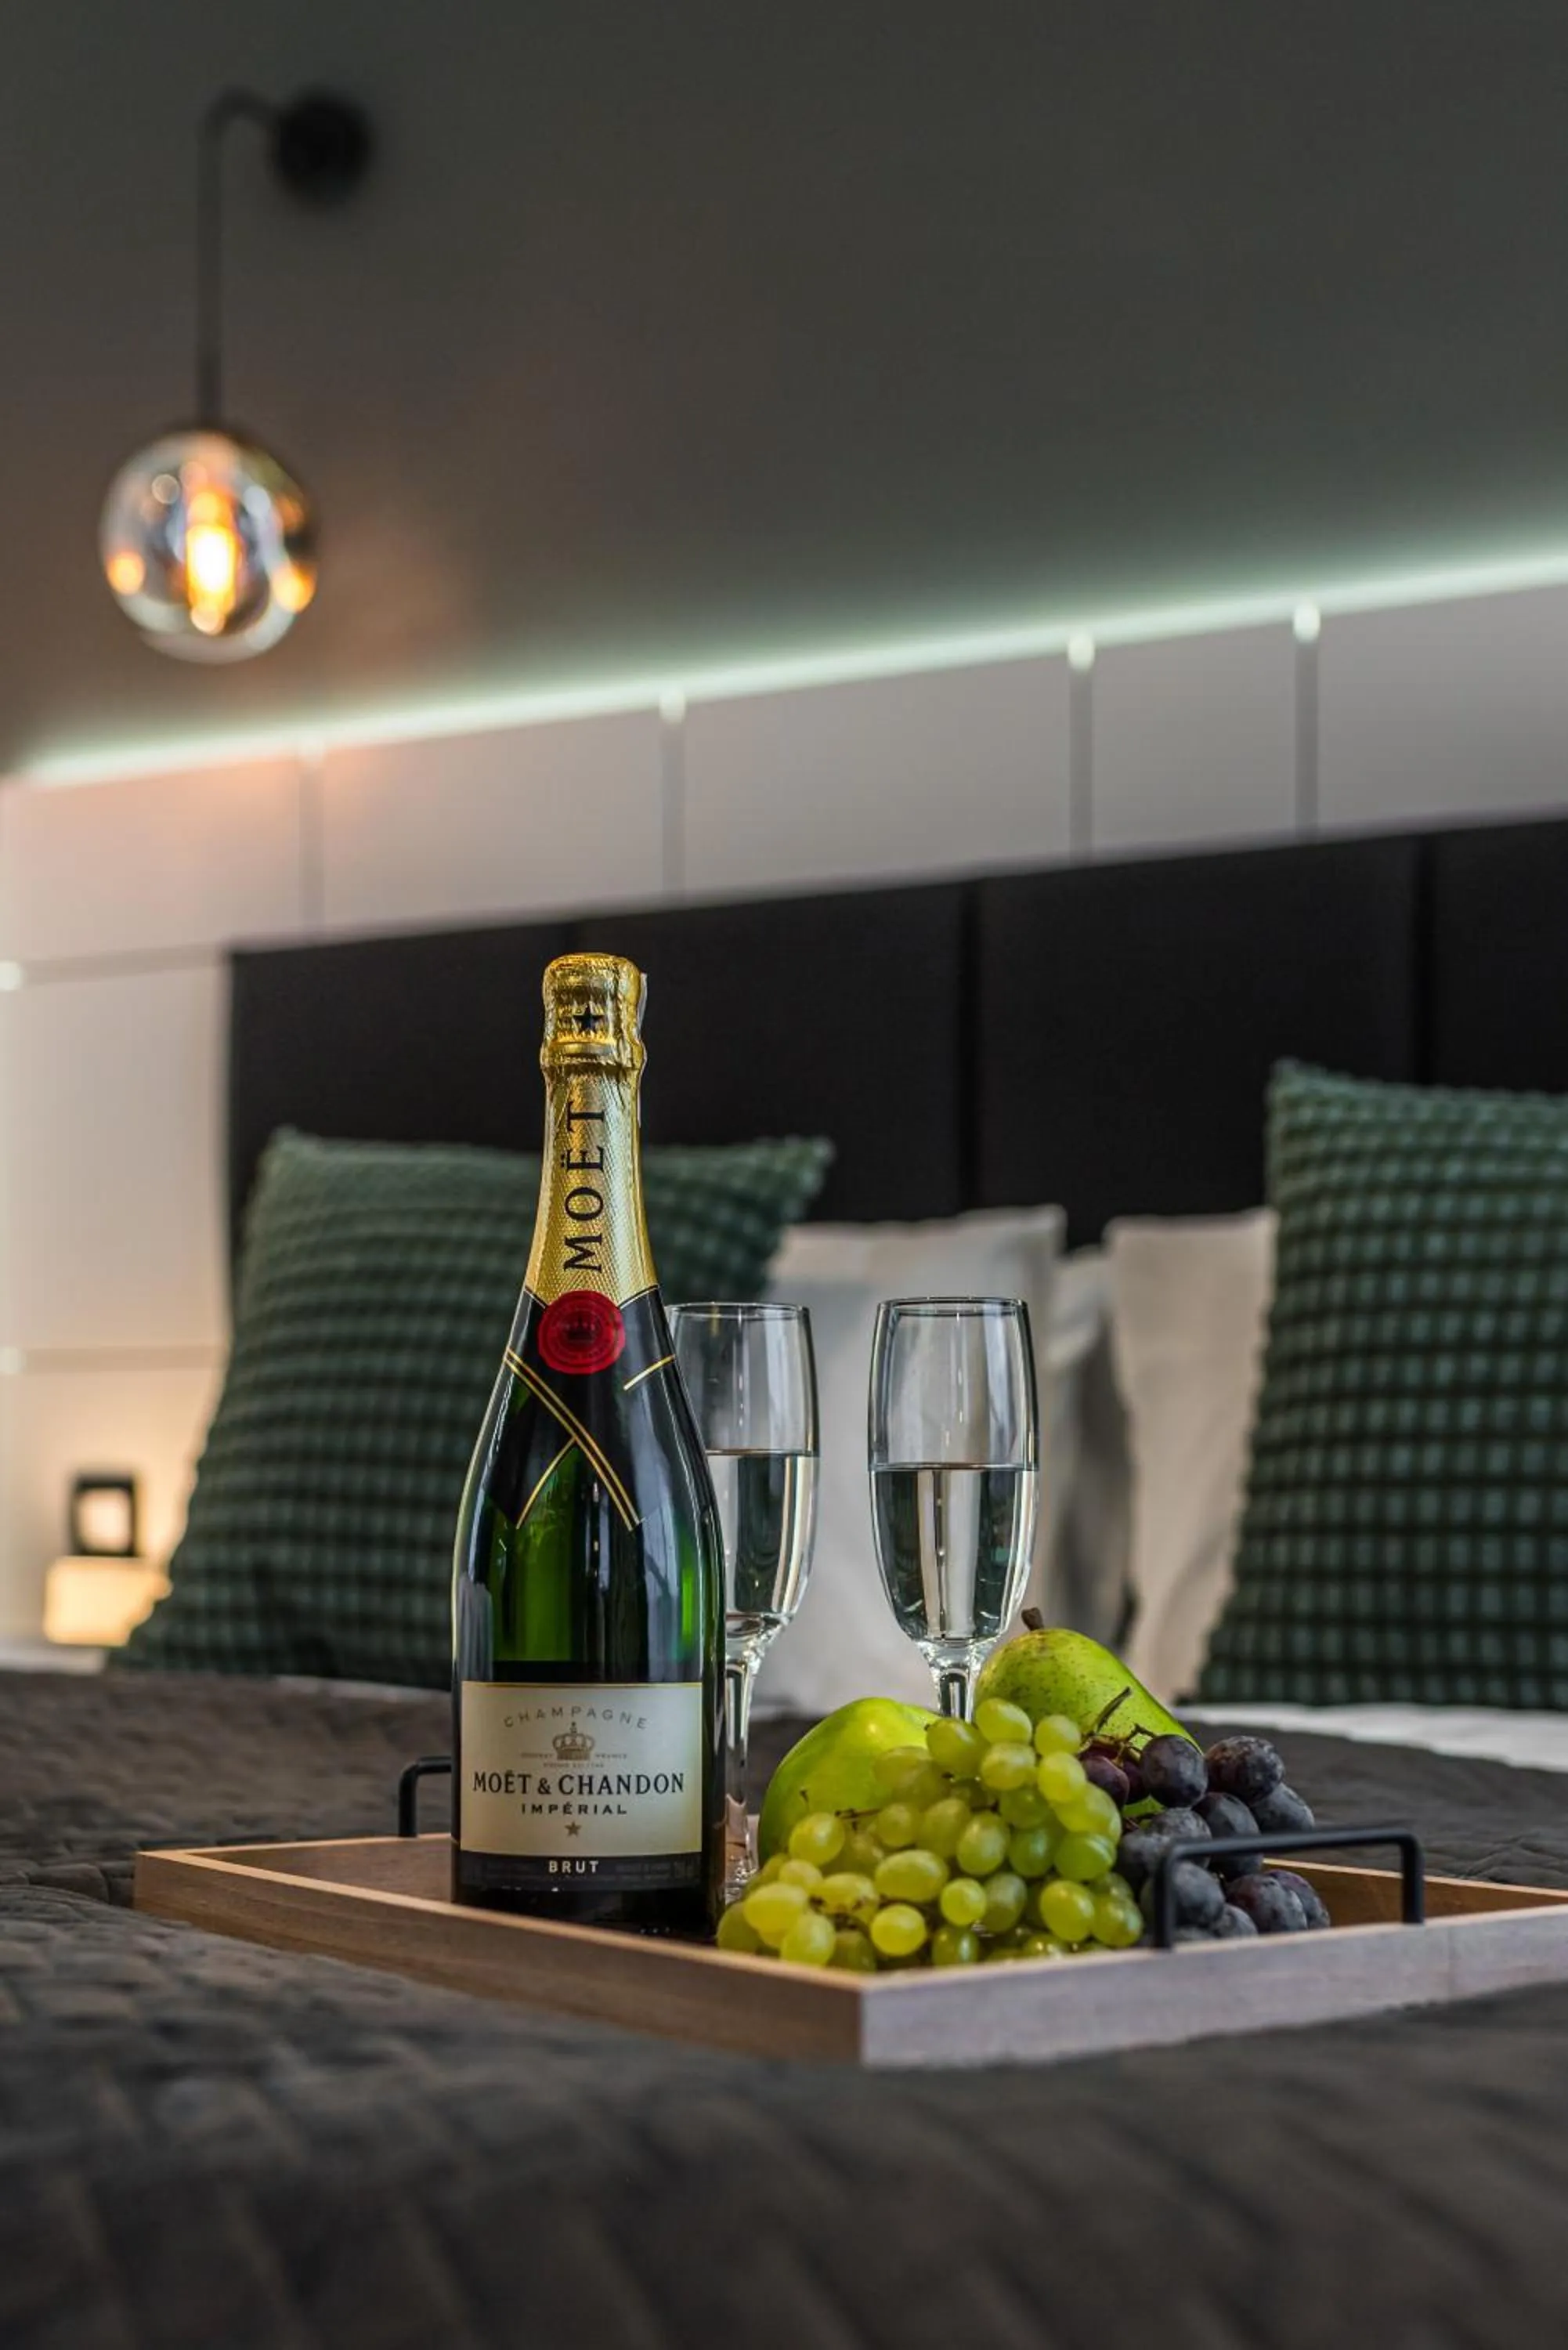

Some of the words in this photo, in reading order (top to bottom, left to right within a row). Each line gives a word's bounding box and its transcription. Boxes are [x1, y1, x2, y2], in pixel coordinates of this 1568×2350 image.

[562, 1101, 605, 1271] MOËT
[504, 1705, 649, 1729] CHAMPAGNE
[473, 1770, 532, 1794] MOËT
[537, 1777, 552, 1795] &
[558, 1773, 684, 1795] CHANDON
[521, 1802, 627, 1814] IMPÉRIAL
[548, 1860, 599, 1873] BRUT
